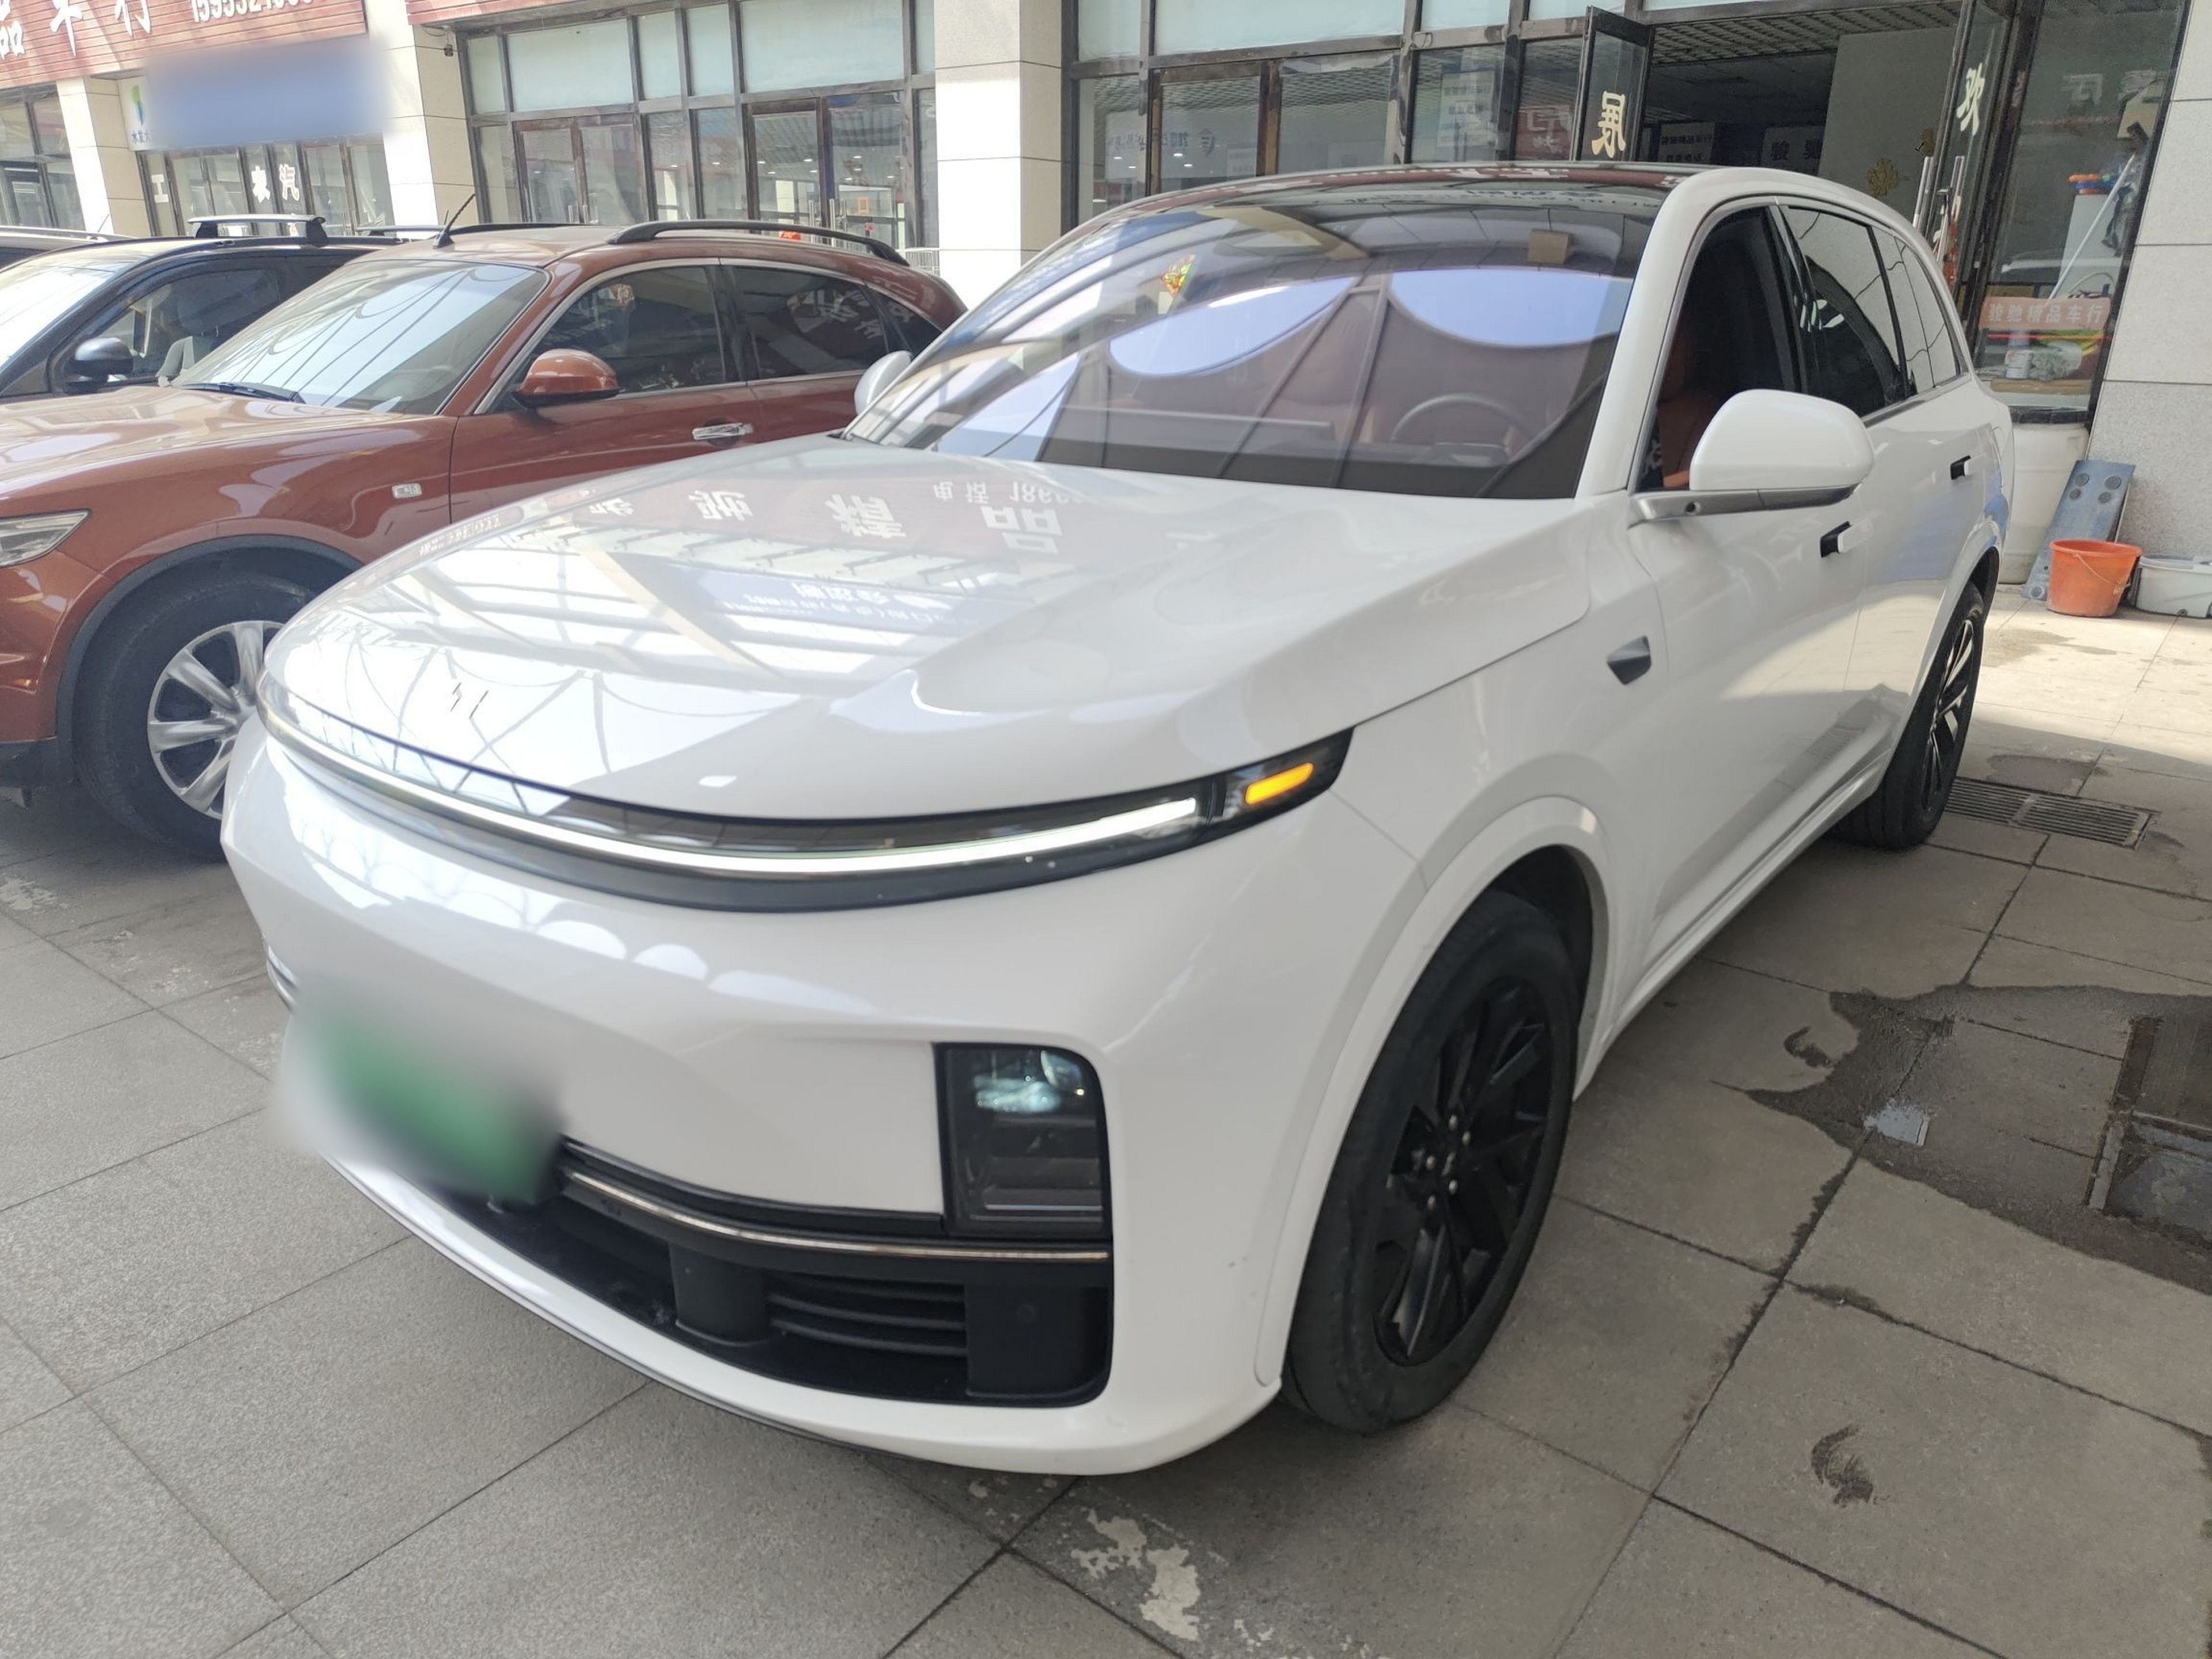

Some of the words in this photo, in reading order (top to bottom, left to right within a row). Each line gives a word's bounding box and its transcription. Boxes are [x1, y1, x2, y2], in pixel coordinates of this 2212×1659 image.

[1989, 303, 2104, 323] 骏驰精品车行
